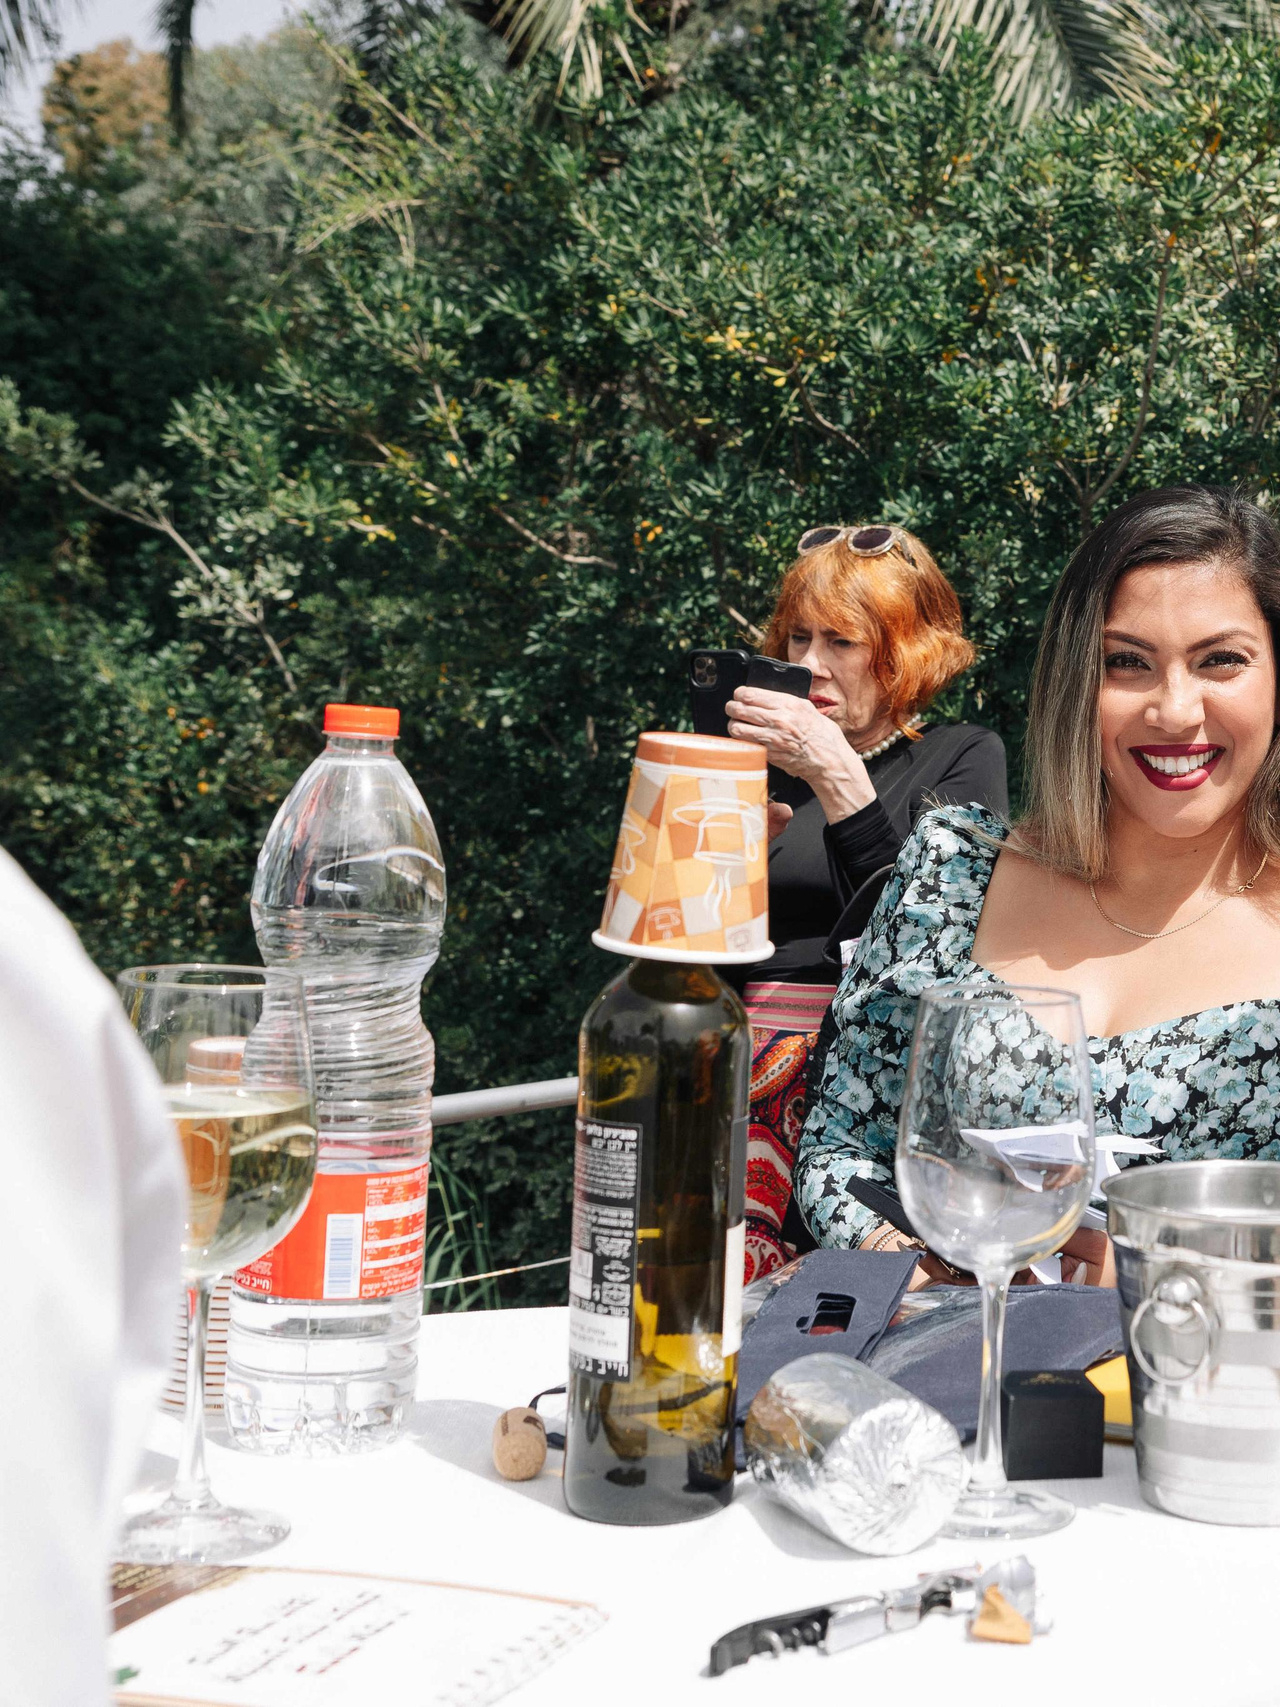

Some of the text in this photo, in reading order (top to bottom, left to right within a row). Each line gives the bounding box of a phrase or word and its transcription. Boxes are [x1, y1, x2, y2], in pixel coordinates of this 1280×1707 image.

[607, 1139, 623, 1151] לבן
[250, 1276, 270, 1291] חייב
[596, 1359, 629, 1377] חייב
